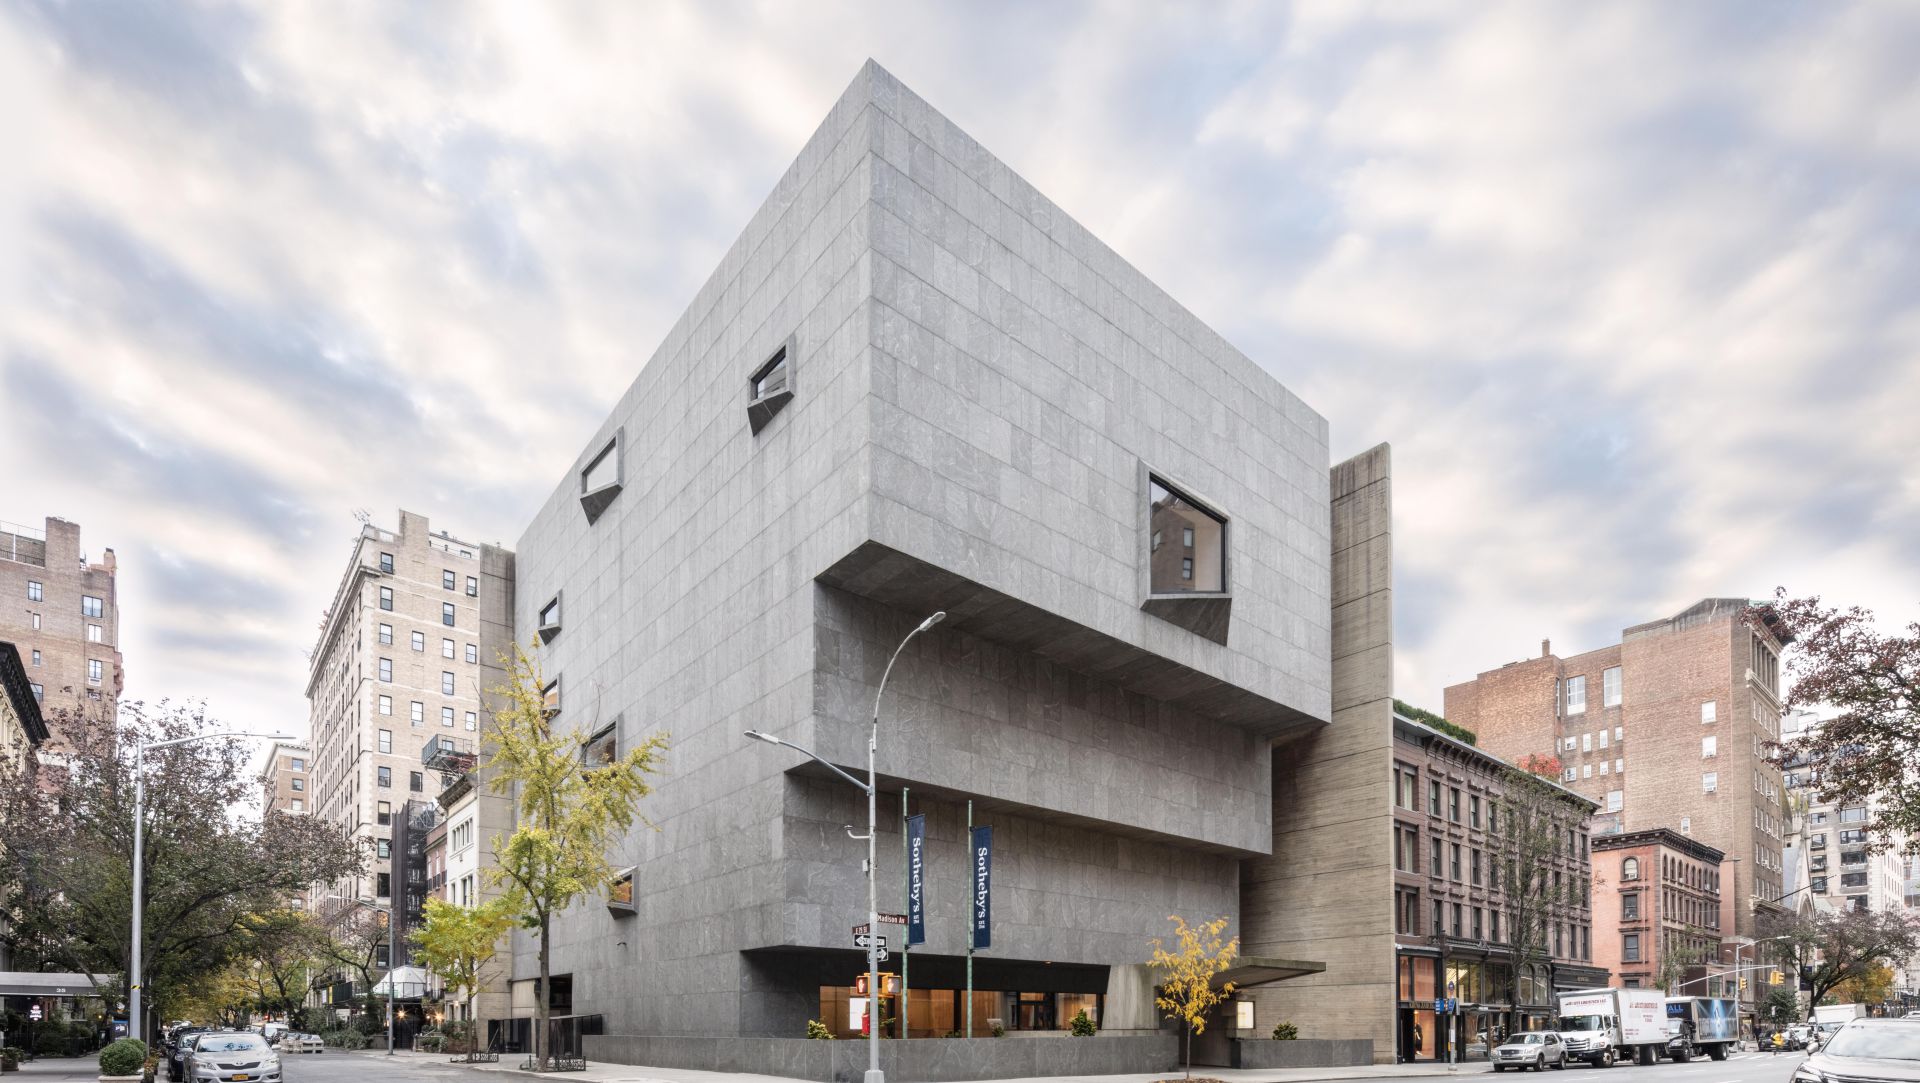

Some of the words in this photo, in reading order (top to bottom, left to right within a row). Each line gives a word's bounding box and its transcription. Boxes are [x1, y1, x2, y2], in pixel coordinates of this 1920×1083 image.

[911, 837, 921, 912] Sotheby's
[976, 847, 987, 918] Sotheby's
[877, 914, 898, 923] Madison
